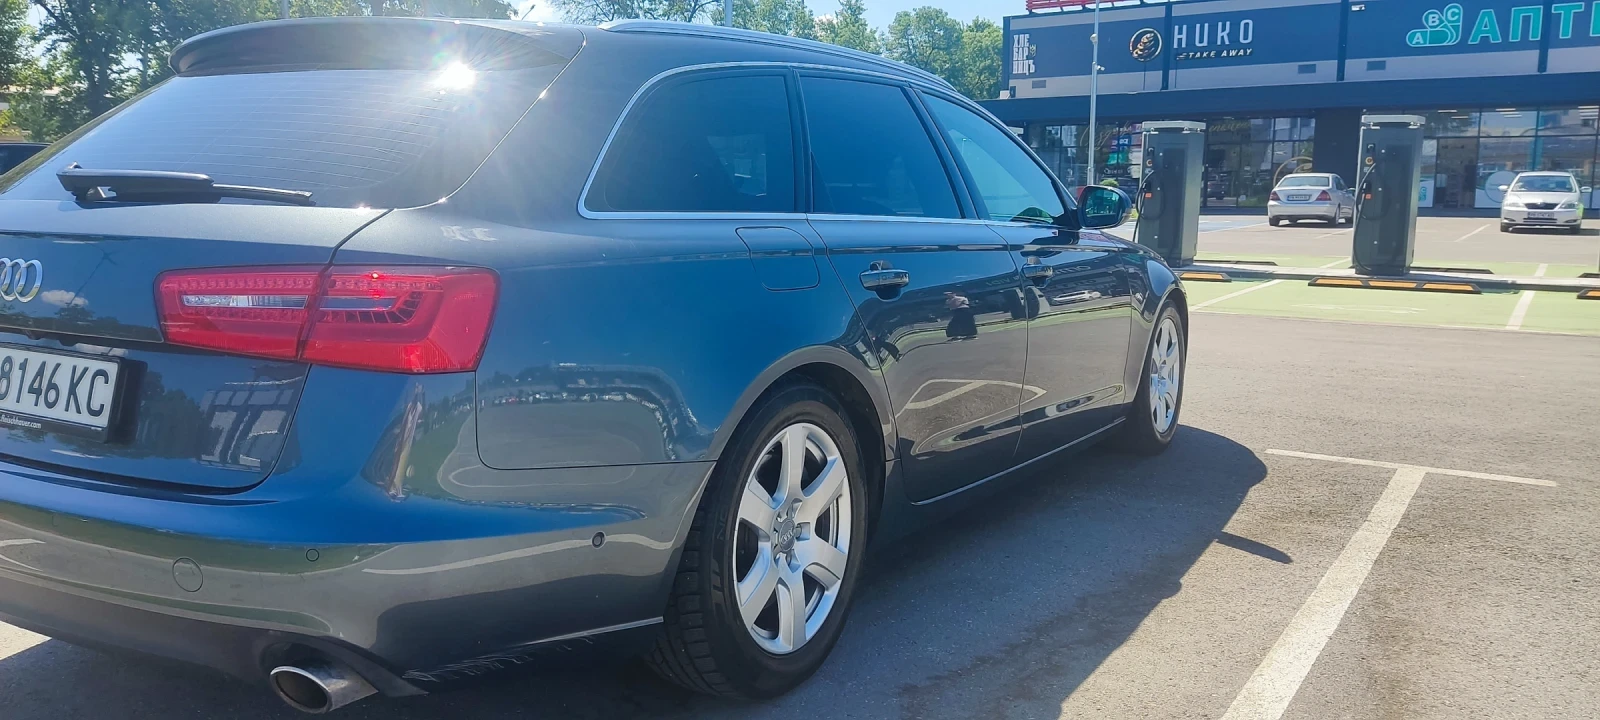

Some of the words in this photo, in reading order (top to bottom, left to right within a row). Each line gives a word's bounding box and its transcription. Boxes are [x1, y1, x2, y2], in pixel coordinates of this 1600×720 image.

[1188, 51, 1217, 59] TAKE
[1221, 48, 1252, 57] AWAY
[0, 355, 61, 409] 8146
[64, 364, 110, 417] KC
